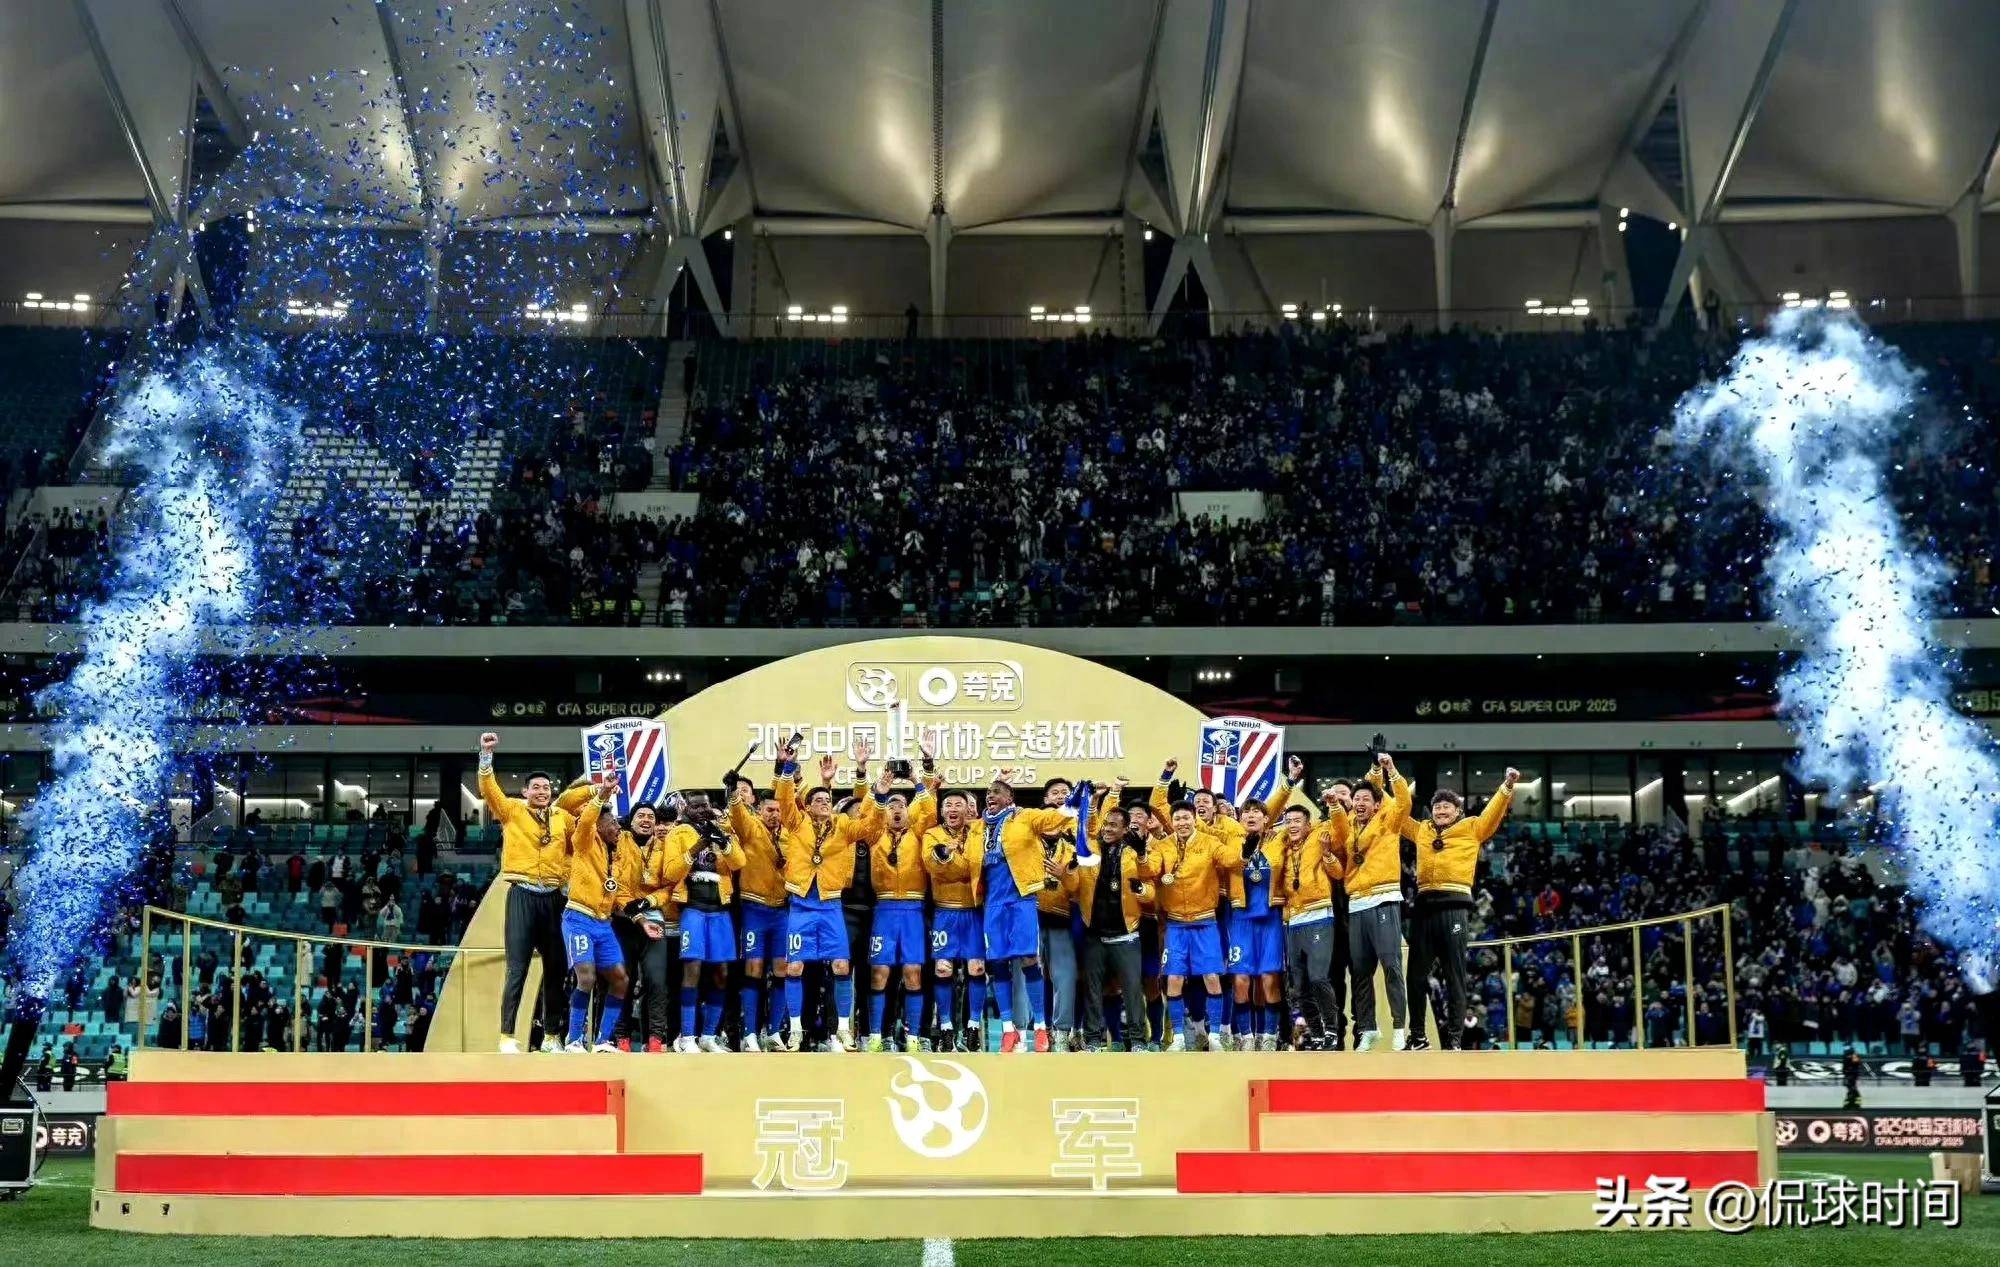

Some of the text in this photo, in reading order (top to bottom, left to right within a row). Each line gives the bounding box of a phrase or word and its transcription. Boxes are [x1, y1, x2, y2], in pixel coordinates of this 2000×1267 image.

[962, 671, 1016, 702] 夸克
[557, 703, 581, 716] CFA
[586, 703, 626, 716] SUPER
[630, 703, 655, 716] CUP
[1482, 700, 1506, 712] CFA
[1510, 700, 1551, 712] SUPER
[1556, 700, 1581, 712] CUP
[1586, 699, 1617, 712] 2025
[604, 720, 642, 731] SHENHUA
[1223, 719, 1261, 729] SHENHUA
[944, 766, 985, 785] CUP
[573, 934, 589, 950] 13
[746, 931, 757, 947] 9
[788, 934, 802, 950] 10
[871, 936, 883, 952] 15
[931, 930, 948, 947] 20
[51, 1127, 83, 1146] 夸克
[1832, 1122, 1864, 1142] 夸克
[751, 1097, 1143, 1191] 冠 军
